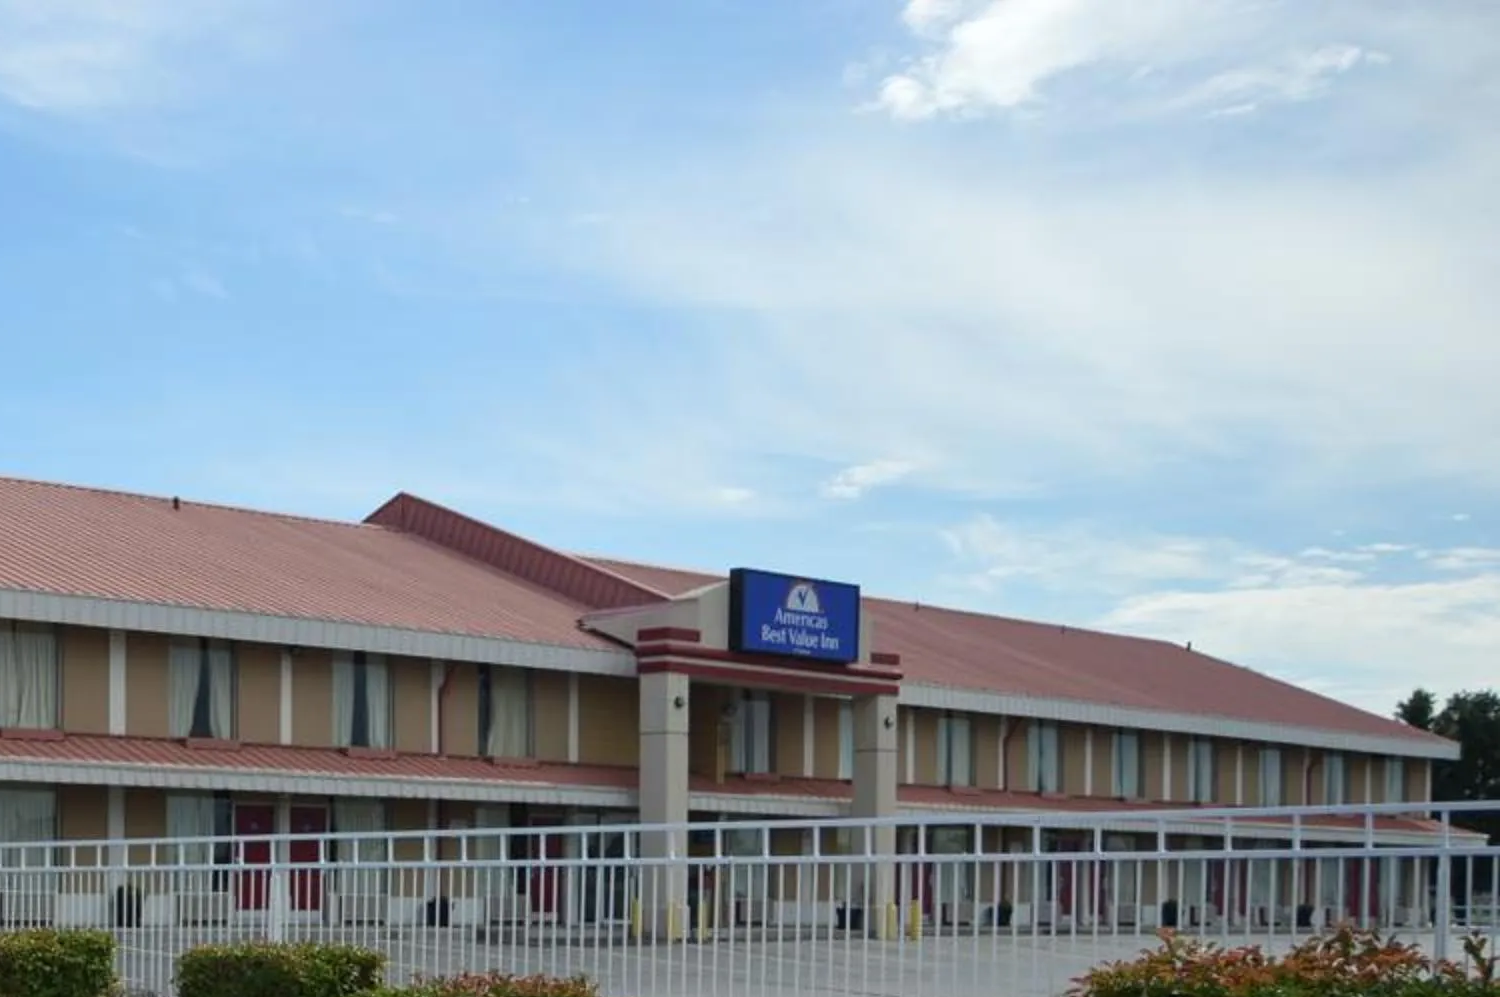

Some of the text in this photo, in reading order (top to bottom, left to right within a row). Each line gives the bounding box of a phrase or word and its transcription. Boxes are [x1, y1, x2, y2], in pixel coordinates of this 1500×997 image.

[773, 607, 828, 630] Americas
[761, 624, 839, 650] Best Value Inn
